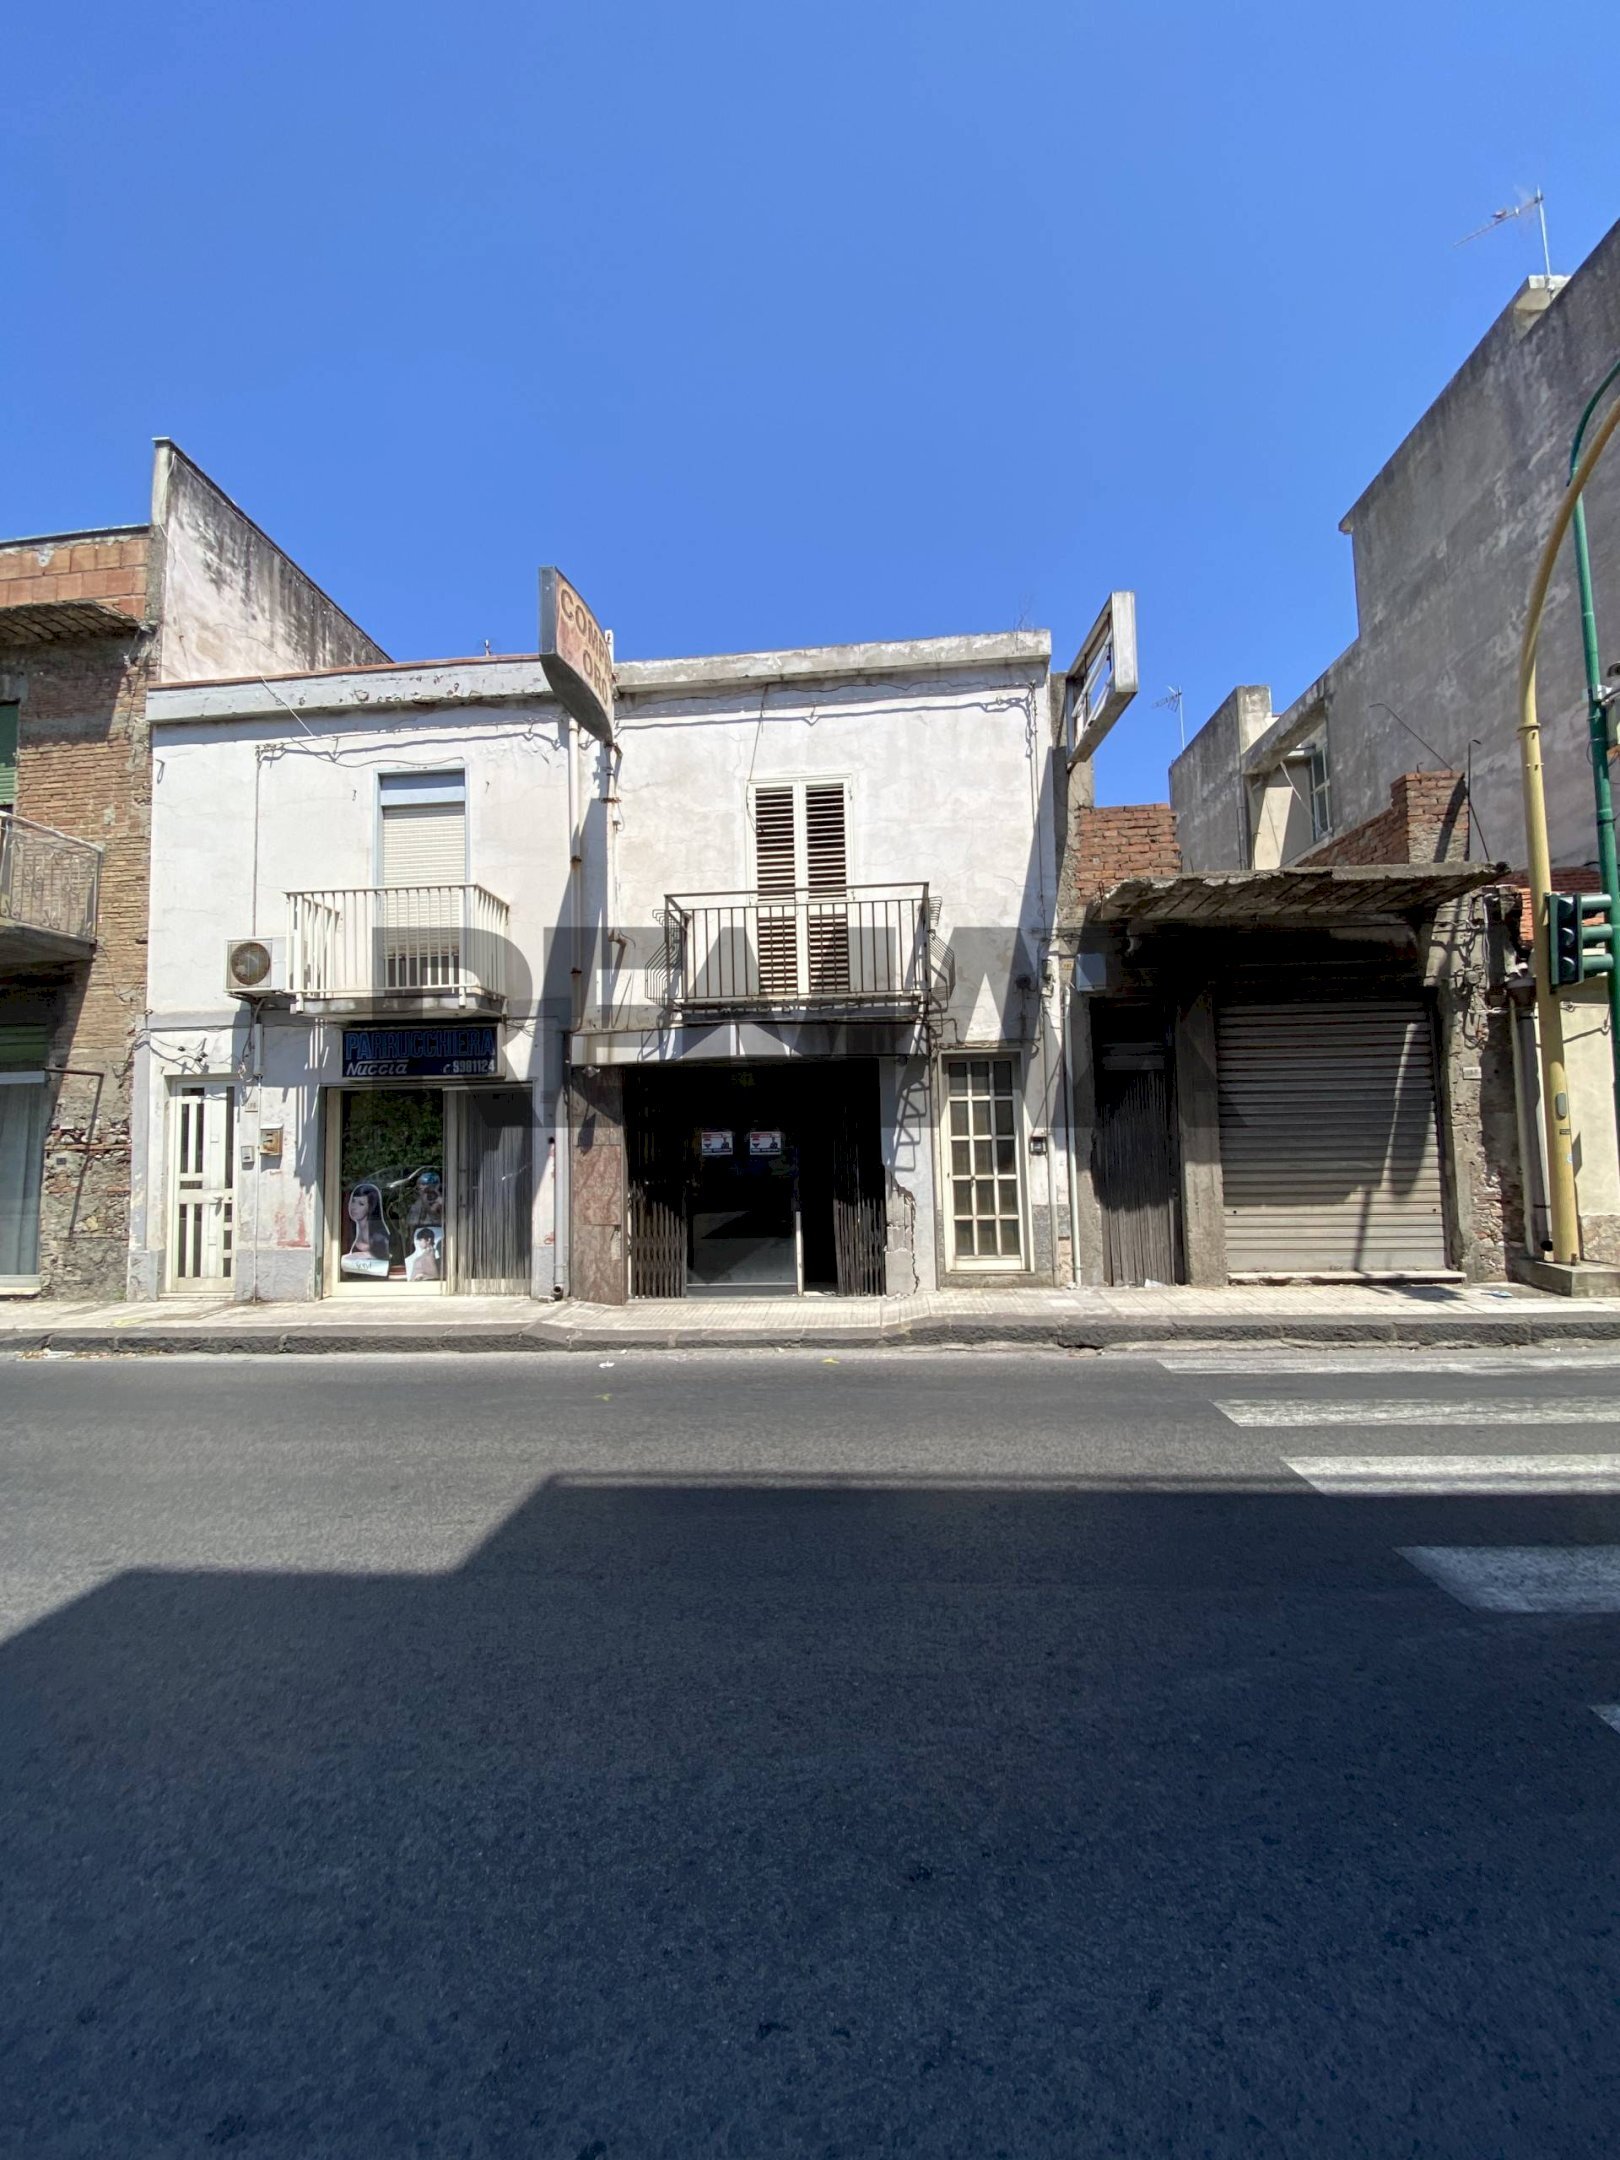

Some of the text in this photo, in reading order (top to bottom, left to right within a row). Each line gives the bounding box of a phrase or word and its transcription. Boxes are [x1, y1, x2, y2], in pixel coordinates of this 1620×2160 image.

[583, 650, 607, 705] ORO
[345, 1029, 495, 1060] PARRUCCHIERA
[346, 1060, 410, 1076] Nuccia
